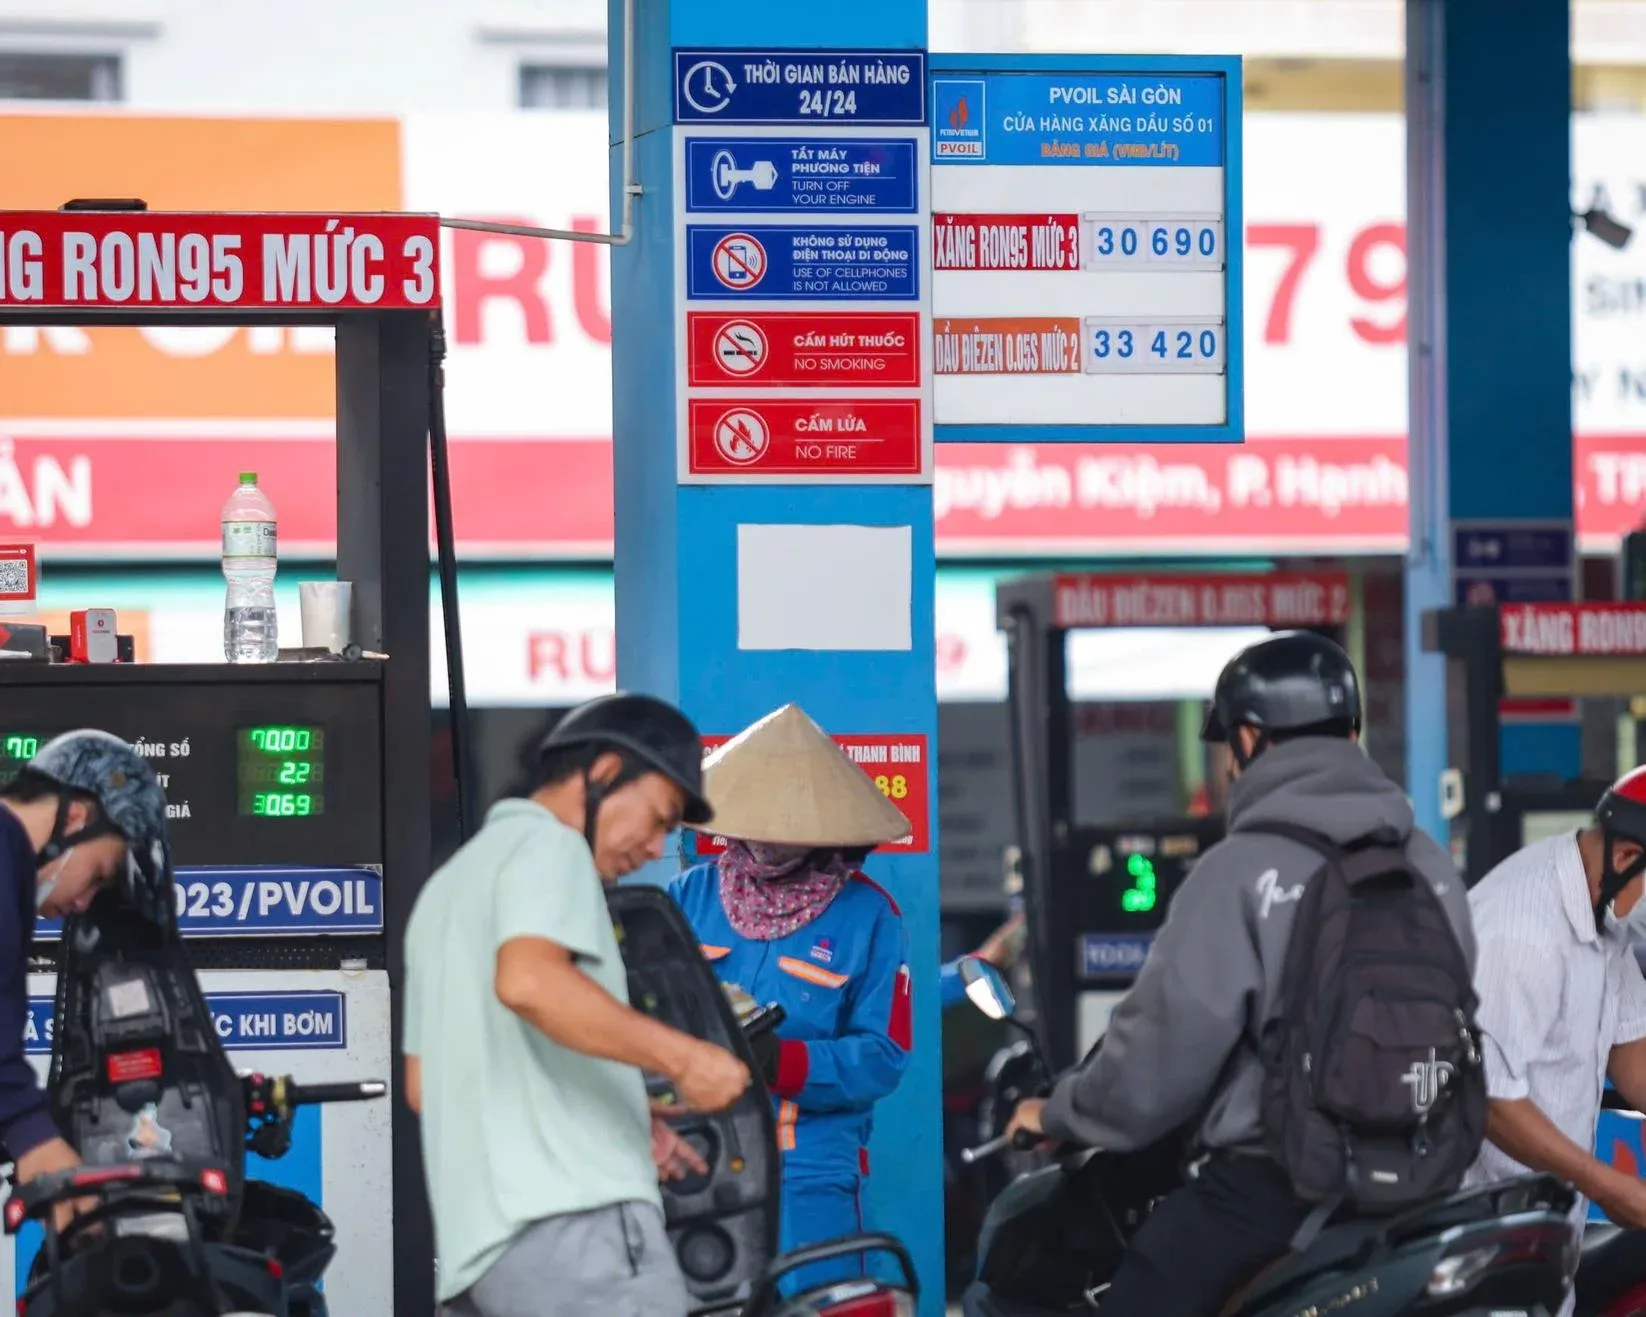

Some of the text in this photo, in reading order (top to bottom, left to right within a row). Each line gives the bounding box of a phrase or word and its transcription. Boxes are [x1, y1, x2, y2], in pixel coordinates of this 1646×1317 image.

[744, 59, 910, 84] THỜI GIAN BÁN HÀNG
[1050, 84, 1181, 104] PVOIL SÀI GÒN
[800, 90, 856, 117] 24/24
[1003, 111, 1213, 133] CỬA HÀNG XĂNG DẦU SỐ 01
[791, 146, 847, 160] TẮT MÁY
[940, 144, 978, 153] PVOIL
[791, 161, 880, 176] PHƯƠNG TIỆN
[792, 181, 850, 191] TURN OFF
[792, 194, 876, 204] YOUR ENGINE
[793, 233, 888, 249] KHÔNG SỬ DỤNG
[935, 216, 1078, 268] XĂNG RON95 MỨC 3
[1097, 228, 1215, 256] 30 690
[62, 231, 243, 302] RON95
[261, 219, 385, 303] MỨC
[402, 236, 434, 304] 3
[793, 248, 908, 262] ĐIỆN THOẠI DI ĐỘNG
[793, 268, 907, 278] USE OF CELLPHONES
[793, 281, 887, 291] IS NOT ALLOWED
[793, 331, 905, 347] CẤM HÚT THUỐC
[935, 320, 959, 371] DẦU
[1041, 325, 1067, 371] MỨC
[1071, 333, 1079, 370] 2
[1094, 330, 1216, 358] 33 420
[794, 359, 886, 370] NO SMOKING
[795, 413, 866, 432] CẤM LỬA
[795, 446, 856, 459] NO FIRE
[170, 737, 190, 757] SỐ
[891, 743, 920, 762] BÌNH
[165, 801, 192, 818] GIÁ
[240, 1014, 276, 1037] KHI
[283, 1010, 333, 1036] BƠM
